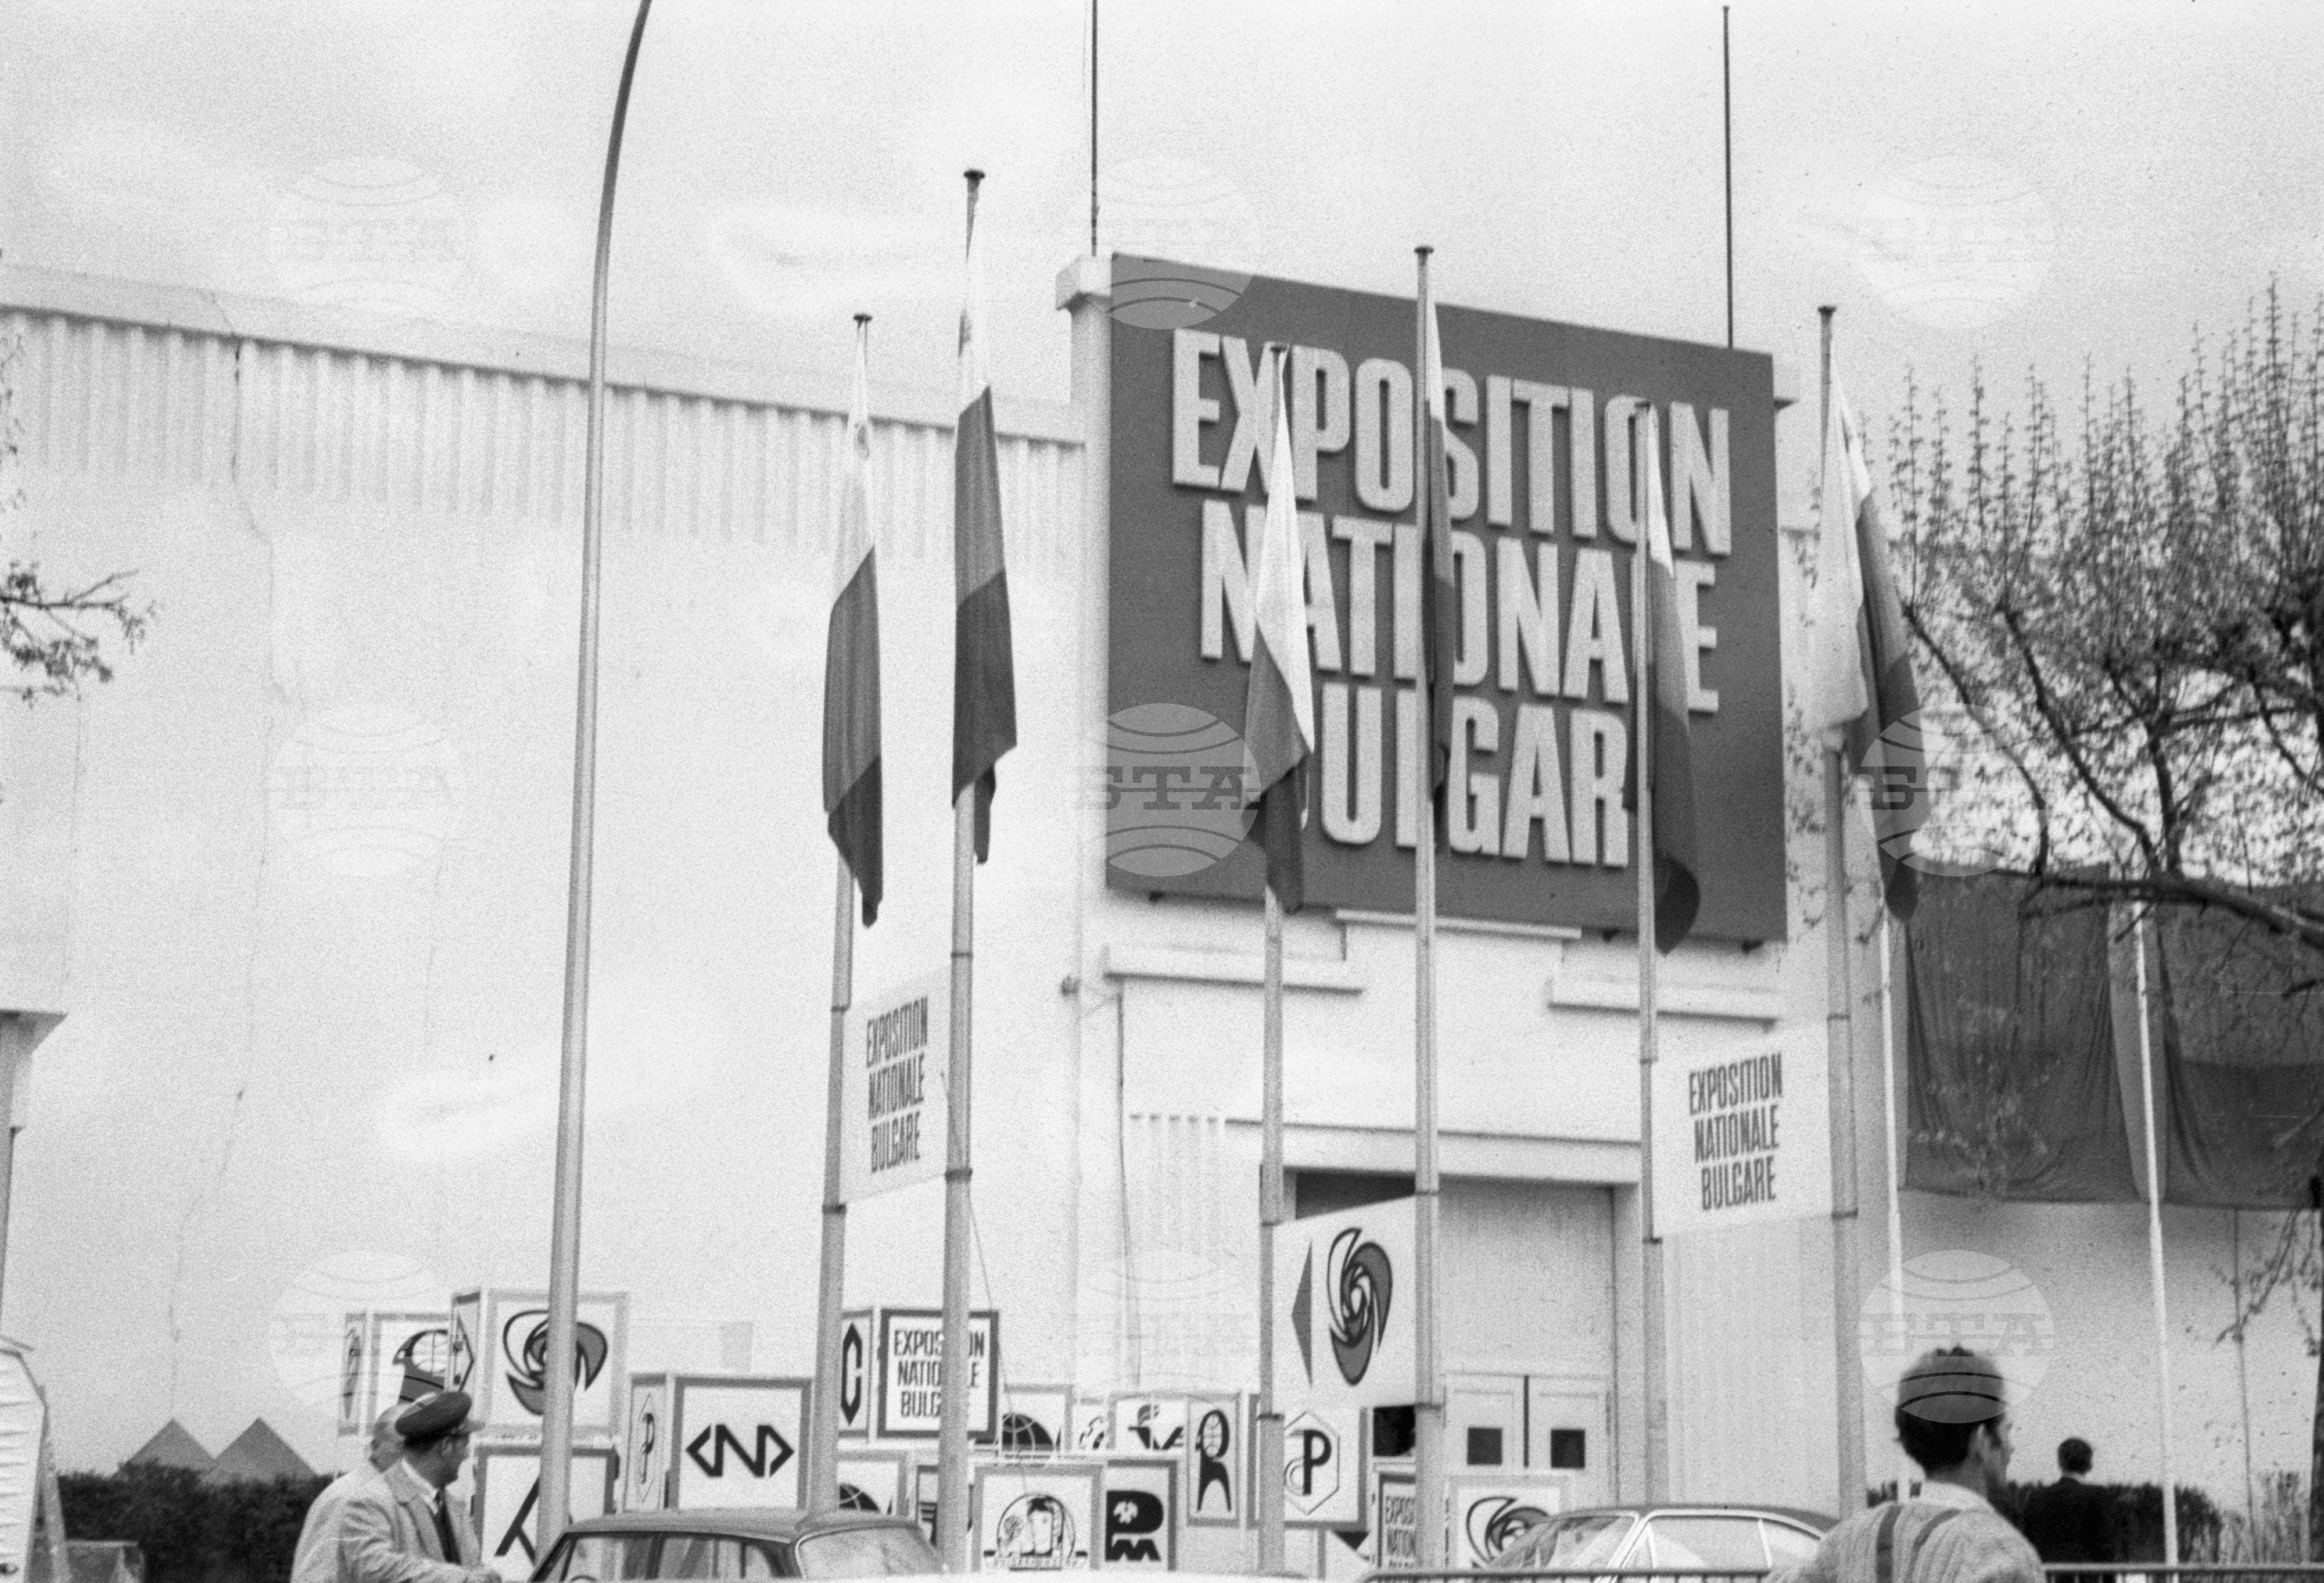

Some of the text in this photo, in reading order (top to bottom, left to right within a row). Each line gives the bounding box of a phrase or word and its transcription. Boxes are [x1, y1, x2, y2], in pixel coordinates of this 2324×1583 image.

[1172, 328, 1731, 555] EXPOSITION
[1201, 499, 1719, 711] NATIONAE
[1301, 682, 1628, 867] ULGAR
[866, 995, 928, 1069] EXPOSITION
[868, 1051, 924, 1121] NATIONALE
[1689, 1052, 1783, 1116] EXPOSITION
[871, 1111, 920, 1174] BULGARE
[1694, 1104, 1780, 1163] NATIONALE
[1701, 1155, 1777, 1212] BULGARE
